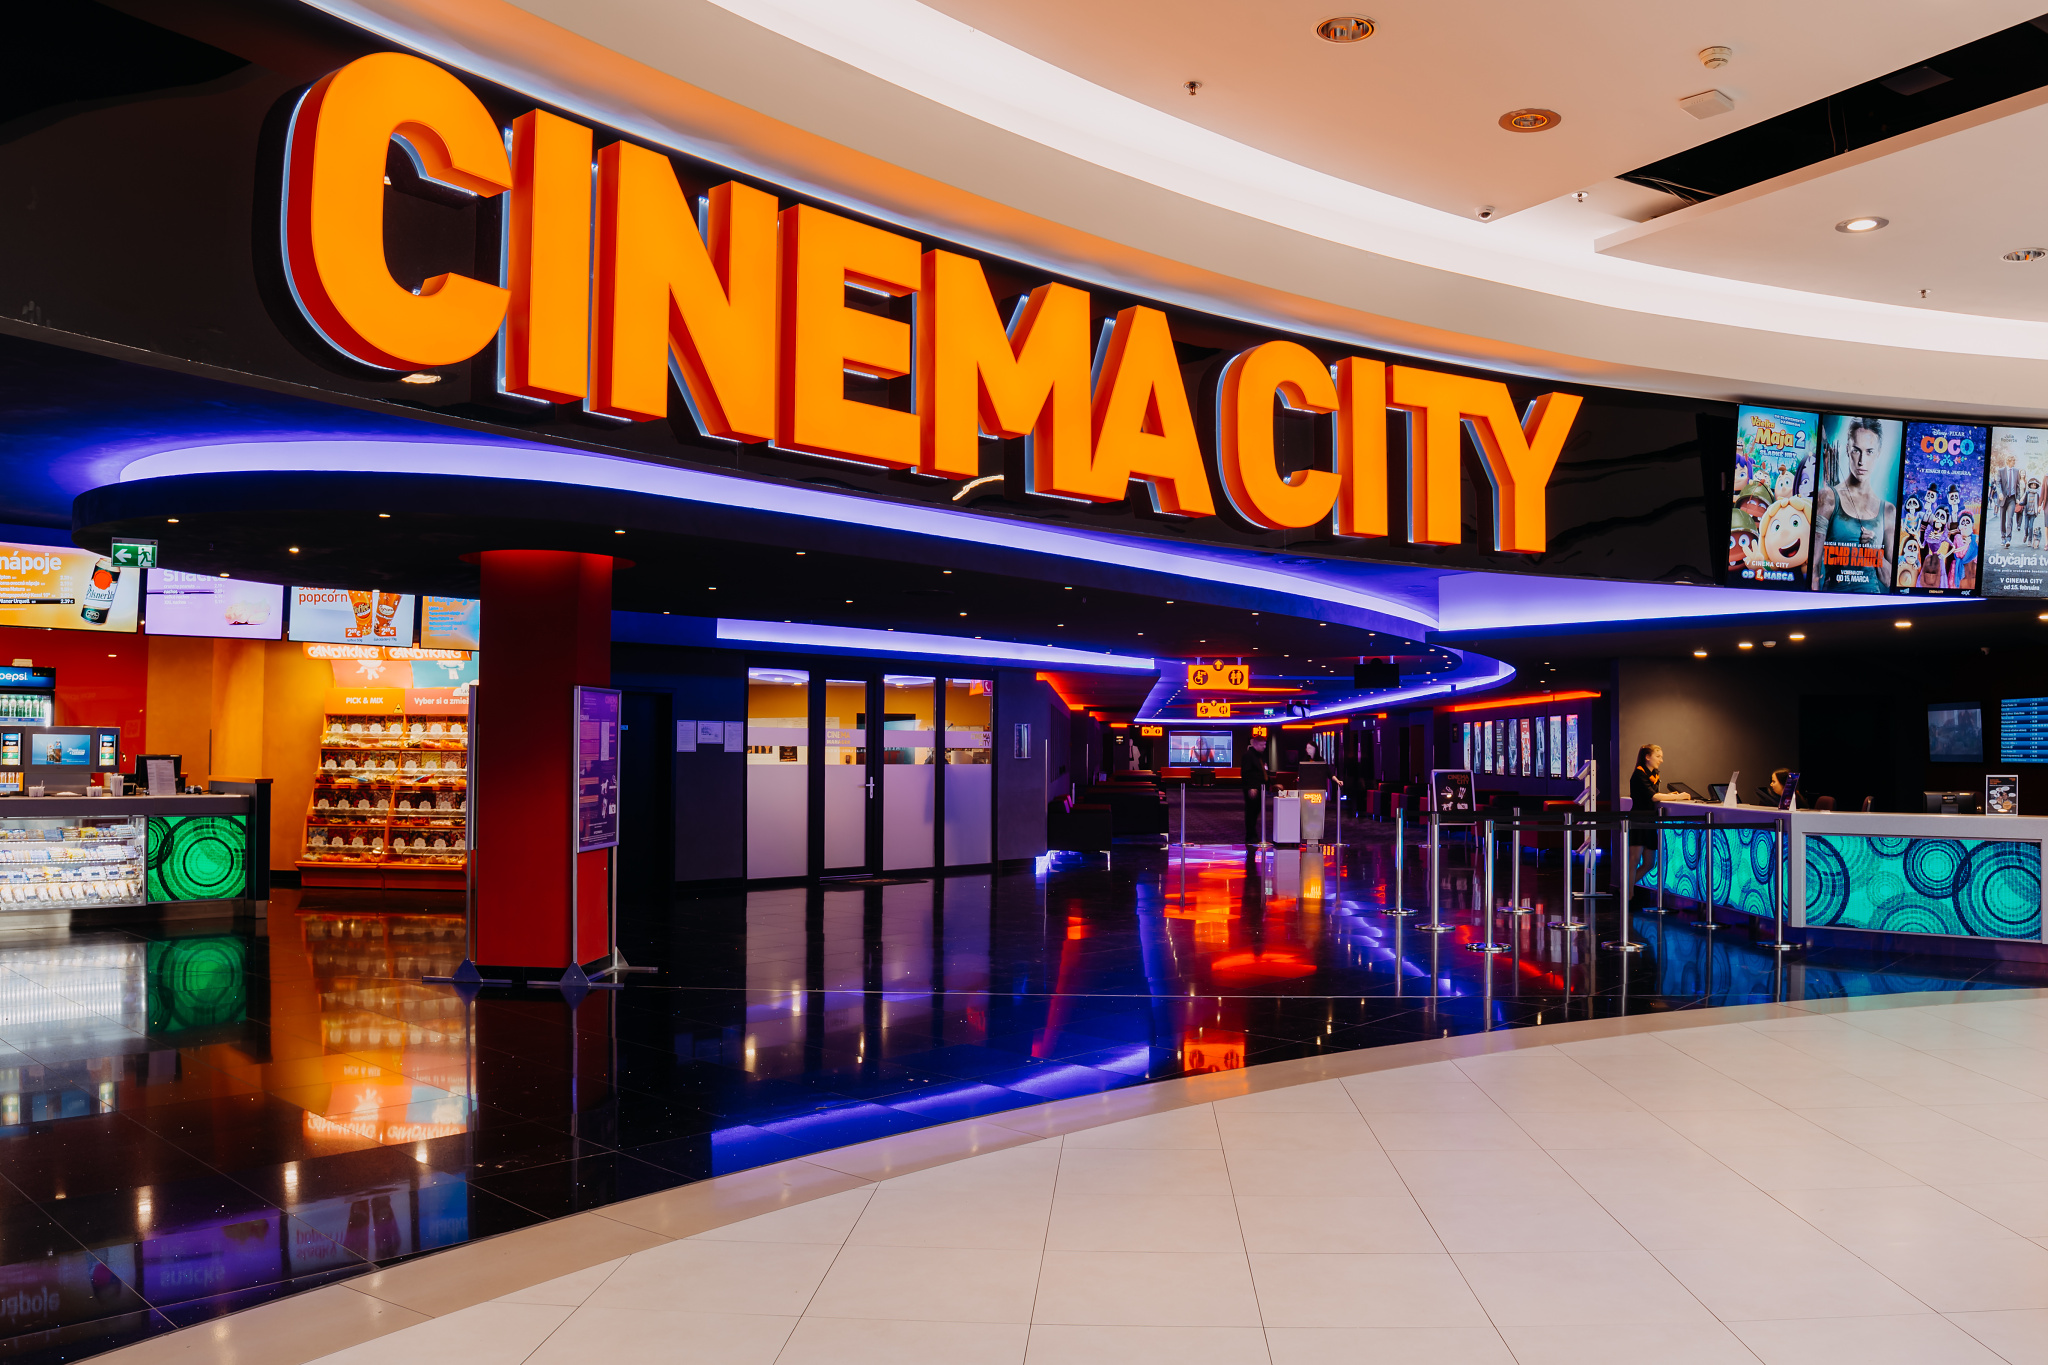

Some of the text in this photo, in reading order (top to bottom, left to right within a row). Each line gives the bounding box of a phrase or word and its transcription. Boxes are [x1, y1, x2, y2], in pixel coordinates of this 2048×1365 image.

[285, 51, 1583, 553] CINEMA CITY
[1755, 428, 1806, 450] Maja 2
[1920, 436, 1974, 455] COCO
[1824, 546, 1884, 568] TOMB RAIDER
[1988, 552, 2037, 568] obyčajná
[1742, 568, 1794, 581] OD 1. MARCA
[299, 592, 348, 605] popcorn
[308, 645, 379, 659] CANDYKING
[389, 648, 461, 659] CANDYKING
[0, 672, 27, 682] pepsi
[414, 698, 434, 706] Vyber
